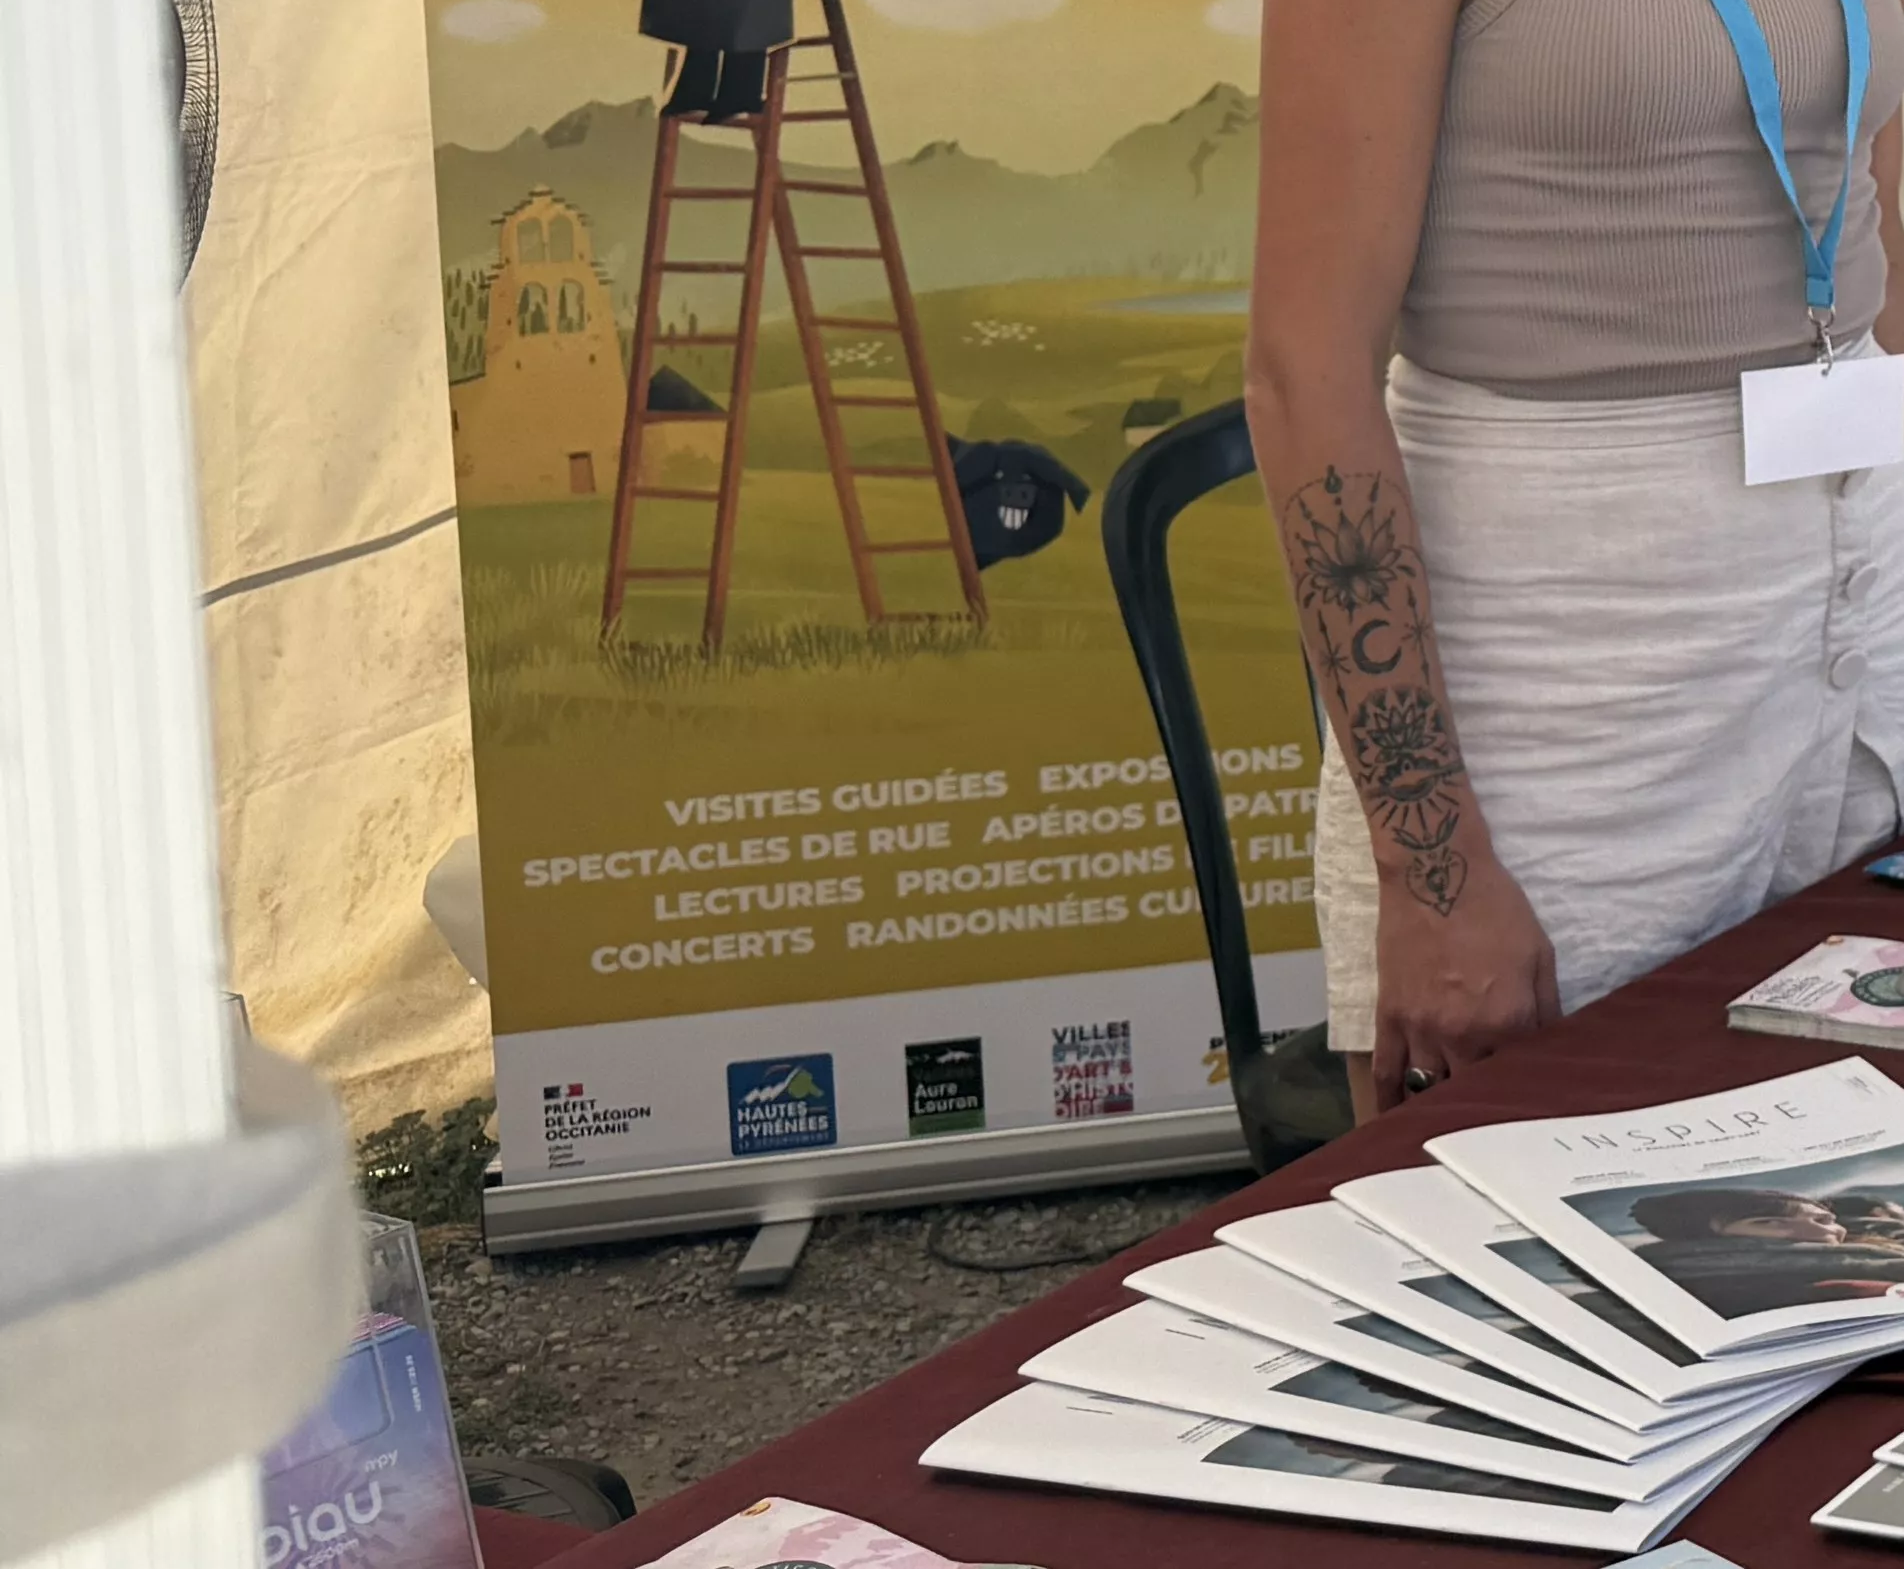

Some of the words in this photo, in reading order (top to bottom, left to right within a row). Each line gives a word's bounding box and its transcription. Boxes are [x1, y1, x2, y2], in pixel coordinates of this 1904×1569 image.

[664, 787, 823, 827] VISITES
[832, 767, 1009, 812] GUIDÉES
[1038, 743, 1304, 794] EXPOSIONS
[523, 836, 792, 888] SPECTACLES
[801, 830, 858, 862] DE
[868, 822, 951, 855] RUE
[982, 801, 1146, 844] APÉROS
[653, 874, 866, 923] LECTURES
[896, 844, 1174, 898] PROJECTIONS
[1248, 833, 1315, 863] FIL
[590, 926, 816, 975] CONCERTS
[846, 893, 1130, 950] RANDONNÉES
[914, 1080, 958, 1100] Aure
[543, 1098, 598, 1116] PRÉFET
[544, 1113, 565, 1130] DE
[568, 1111, 591, 1127] LA
[592, 1105, 652, 1124] RÉGION
[736, 1100, 808, 1123] HAUTES
[913, 1095, 979, 1116] Louron
[545, 1120, 631, 1143] OCCITANIE
[737, 1113, 830, 1140] PYRÉNÉES
[1554, 1100, 1808, 1152] INSPIRE
